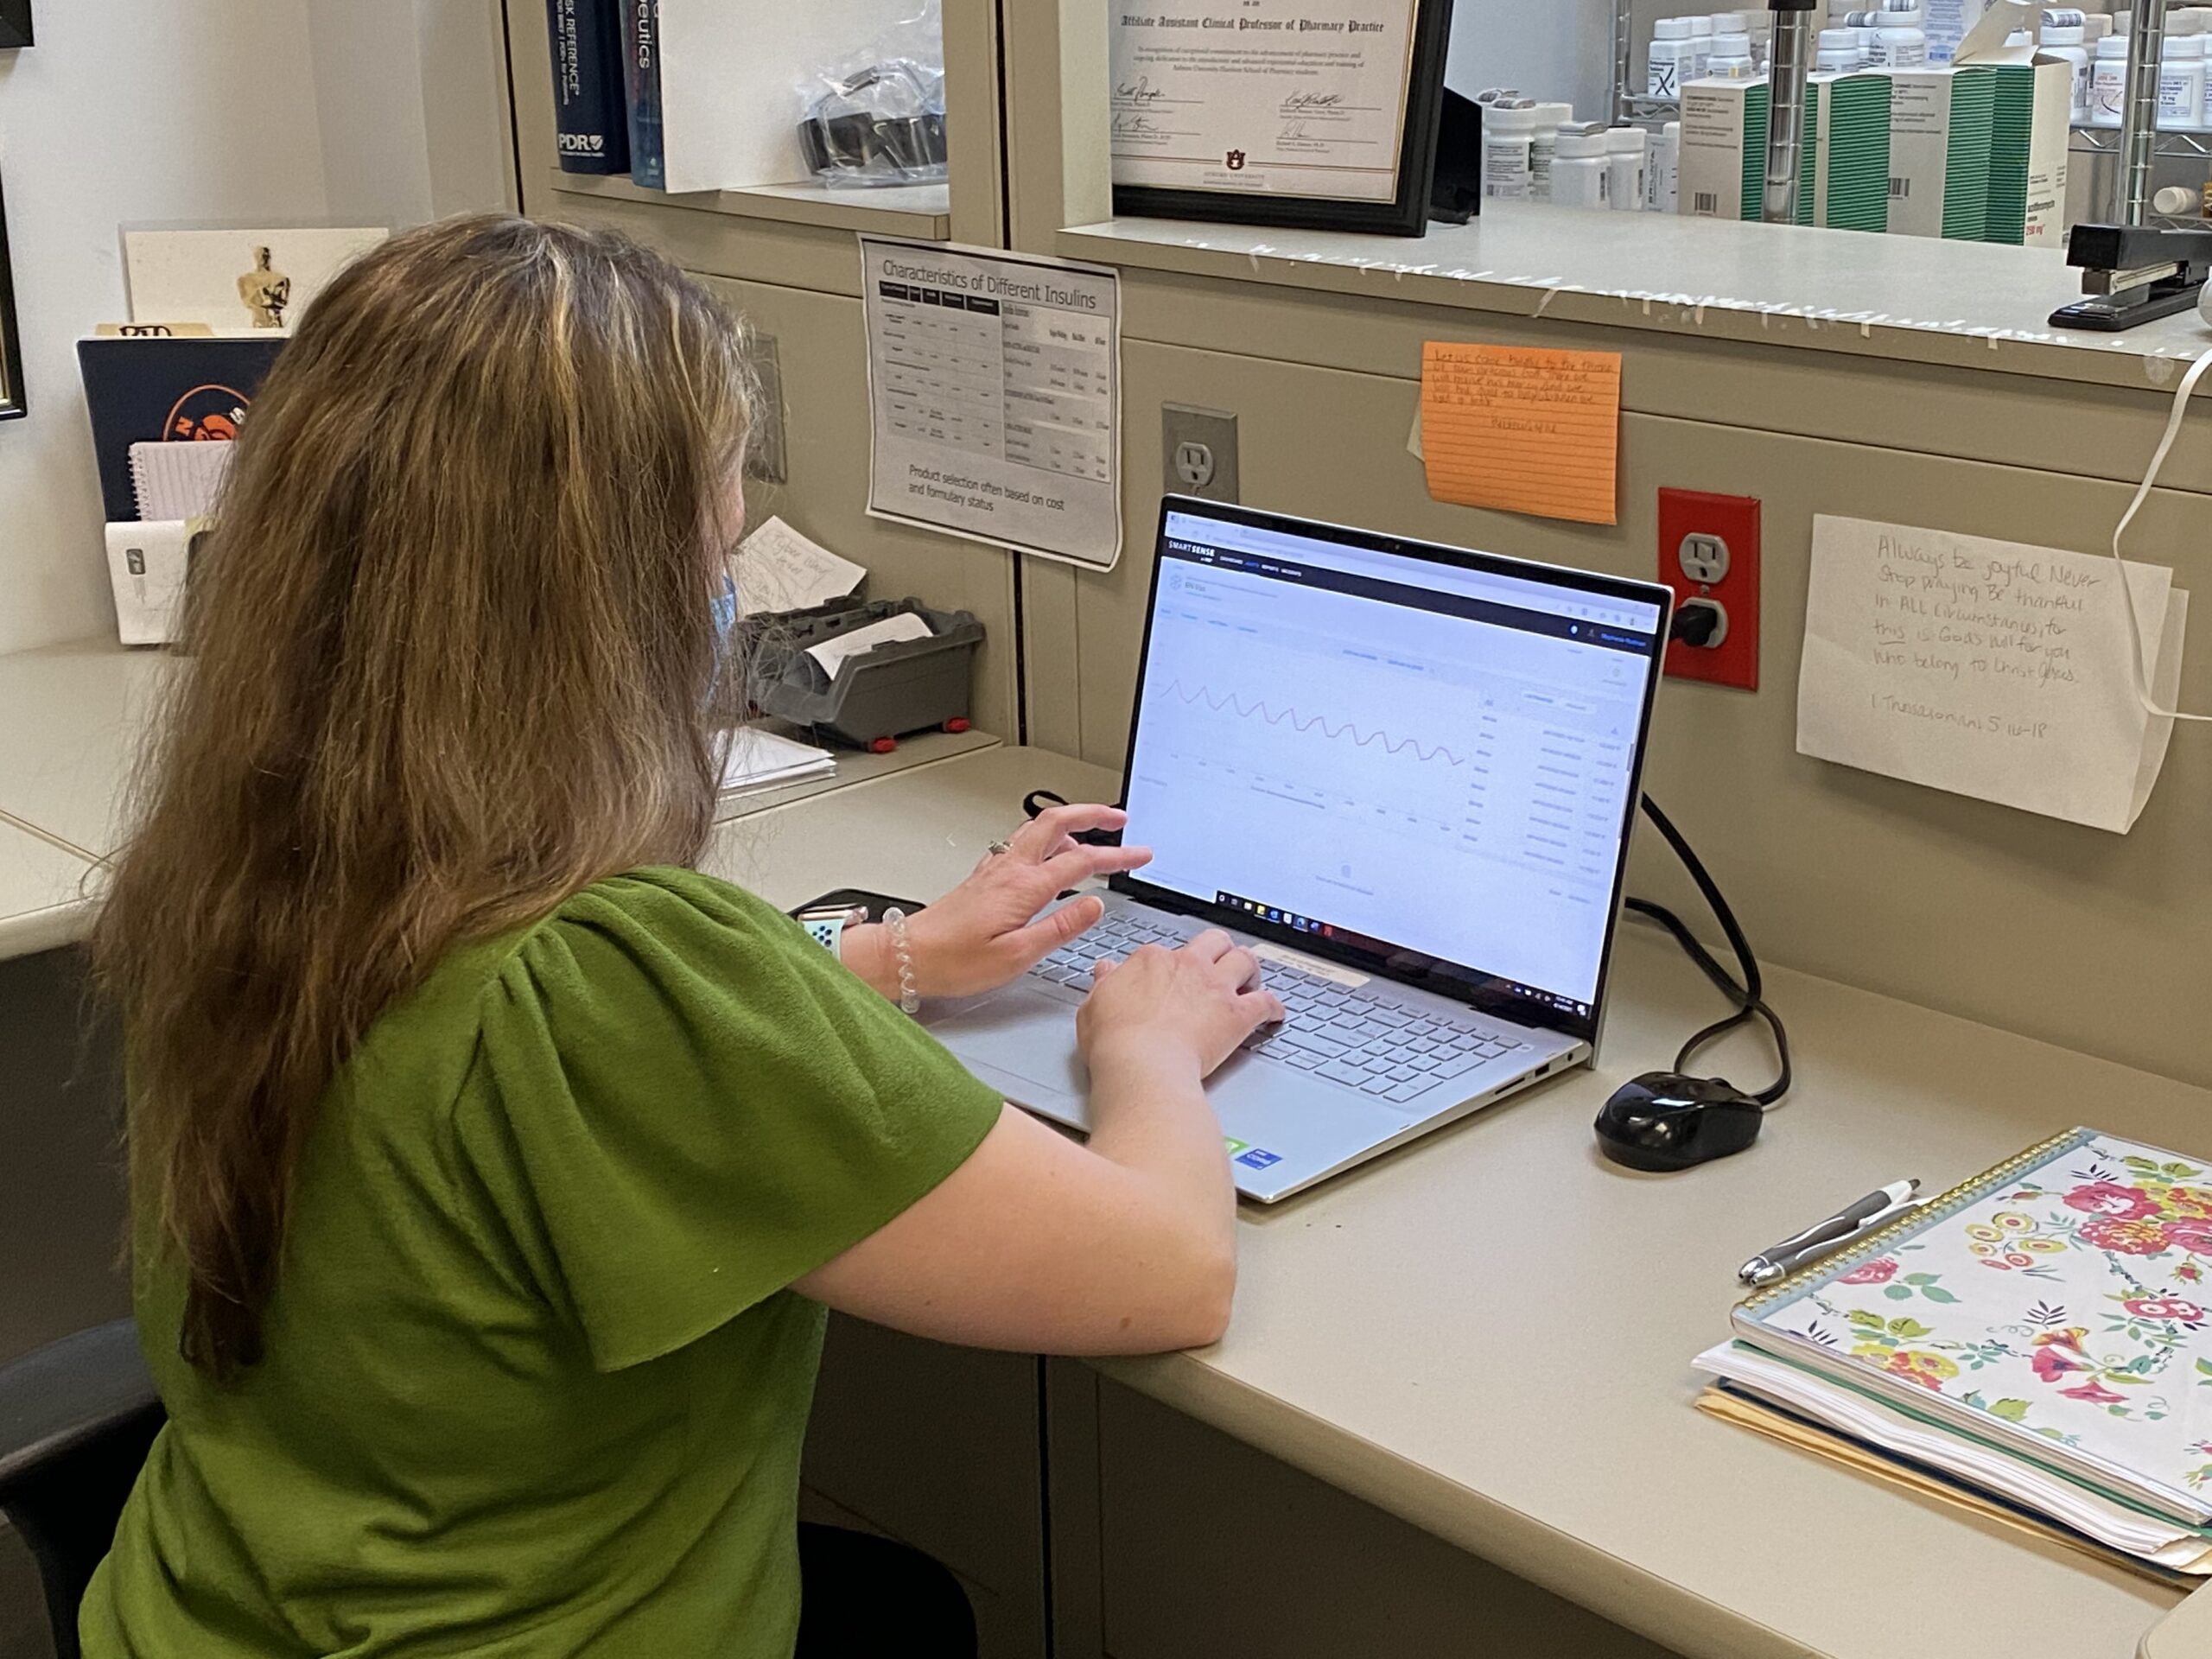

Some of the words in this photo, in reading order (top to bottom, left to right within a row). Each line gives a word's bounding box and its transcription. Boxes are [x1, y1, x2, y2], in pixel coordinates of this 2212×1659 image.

[638, 0, 653, 69] eutics
[1158, 16, 1198, 28] Assistant
[1202, 17, 1235, 29] Clinical
[1239, 17, 1283, 31] Professor
[1286, 19, 1295, 30] of
[1300, 19, 1344, 33] Pharmacy
[1349, 20, 1384, 33] Practice
[558, 133, 591, 150] PDR
[883, 259, 968, 289] Characteristics
[971, 274, 984, 290] of
[988, 276, 1040, 301] Different
[1046, 285, 1096, 308] Insulins
[909, 464, 940, 482] Product
[943, 474, 978, 491] selection
[981, 482, 1001, 497] often
[1004, 486, 1029, 503] based
[1032, 495, 1044, 506] on
[1046, 498, 1065, 512] cost
[909, 483, 925, 496] and
[927, 485, 965, 507] formulary
[968, 497, 994, 512] status
[1878, 535, 1945, 579] Always
[2050, 565, 2101, 588] Never
